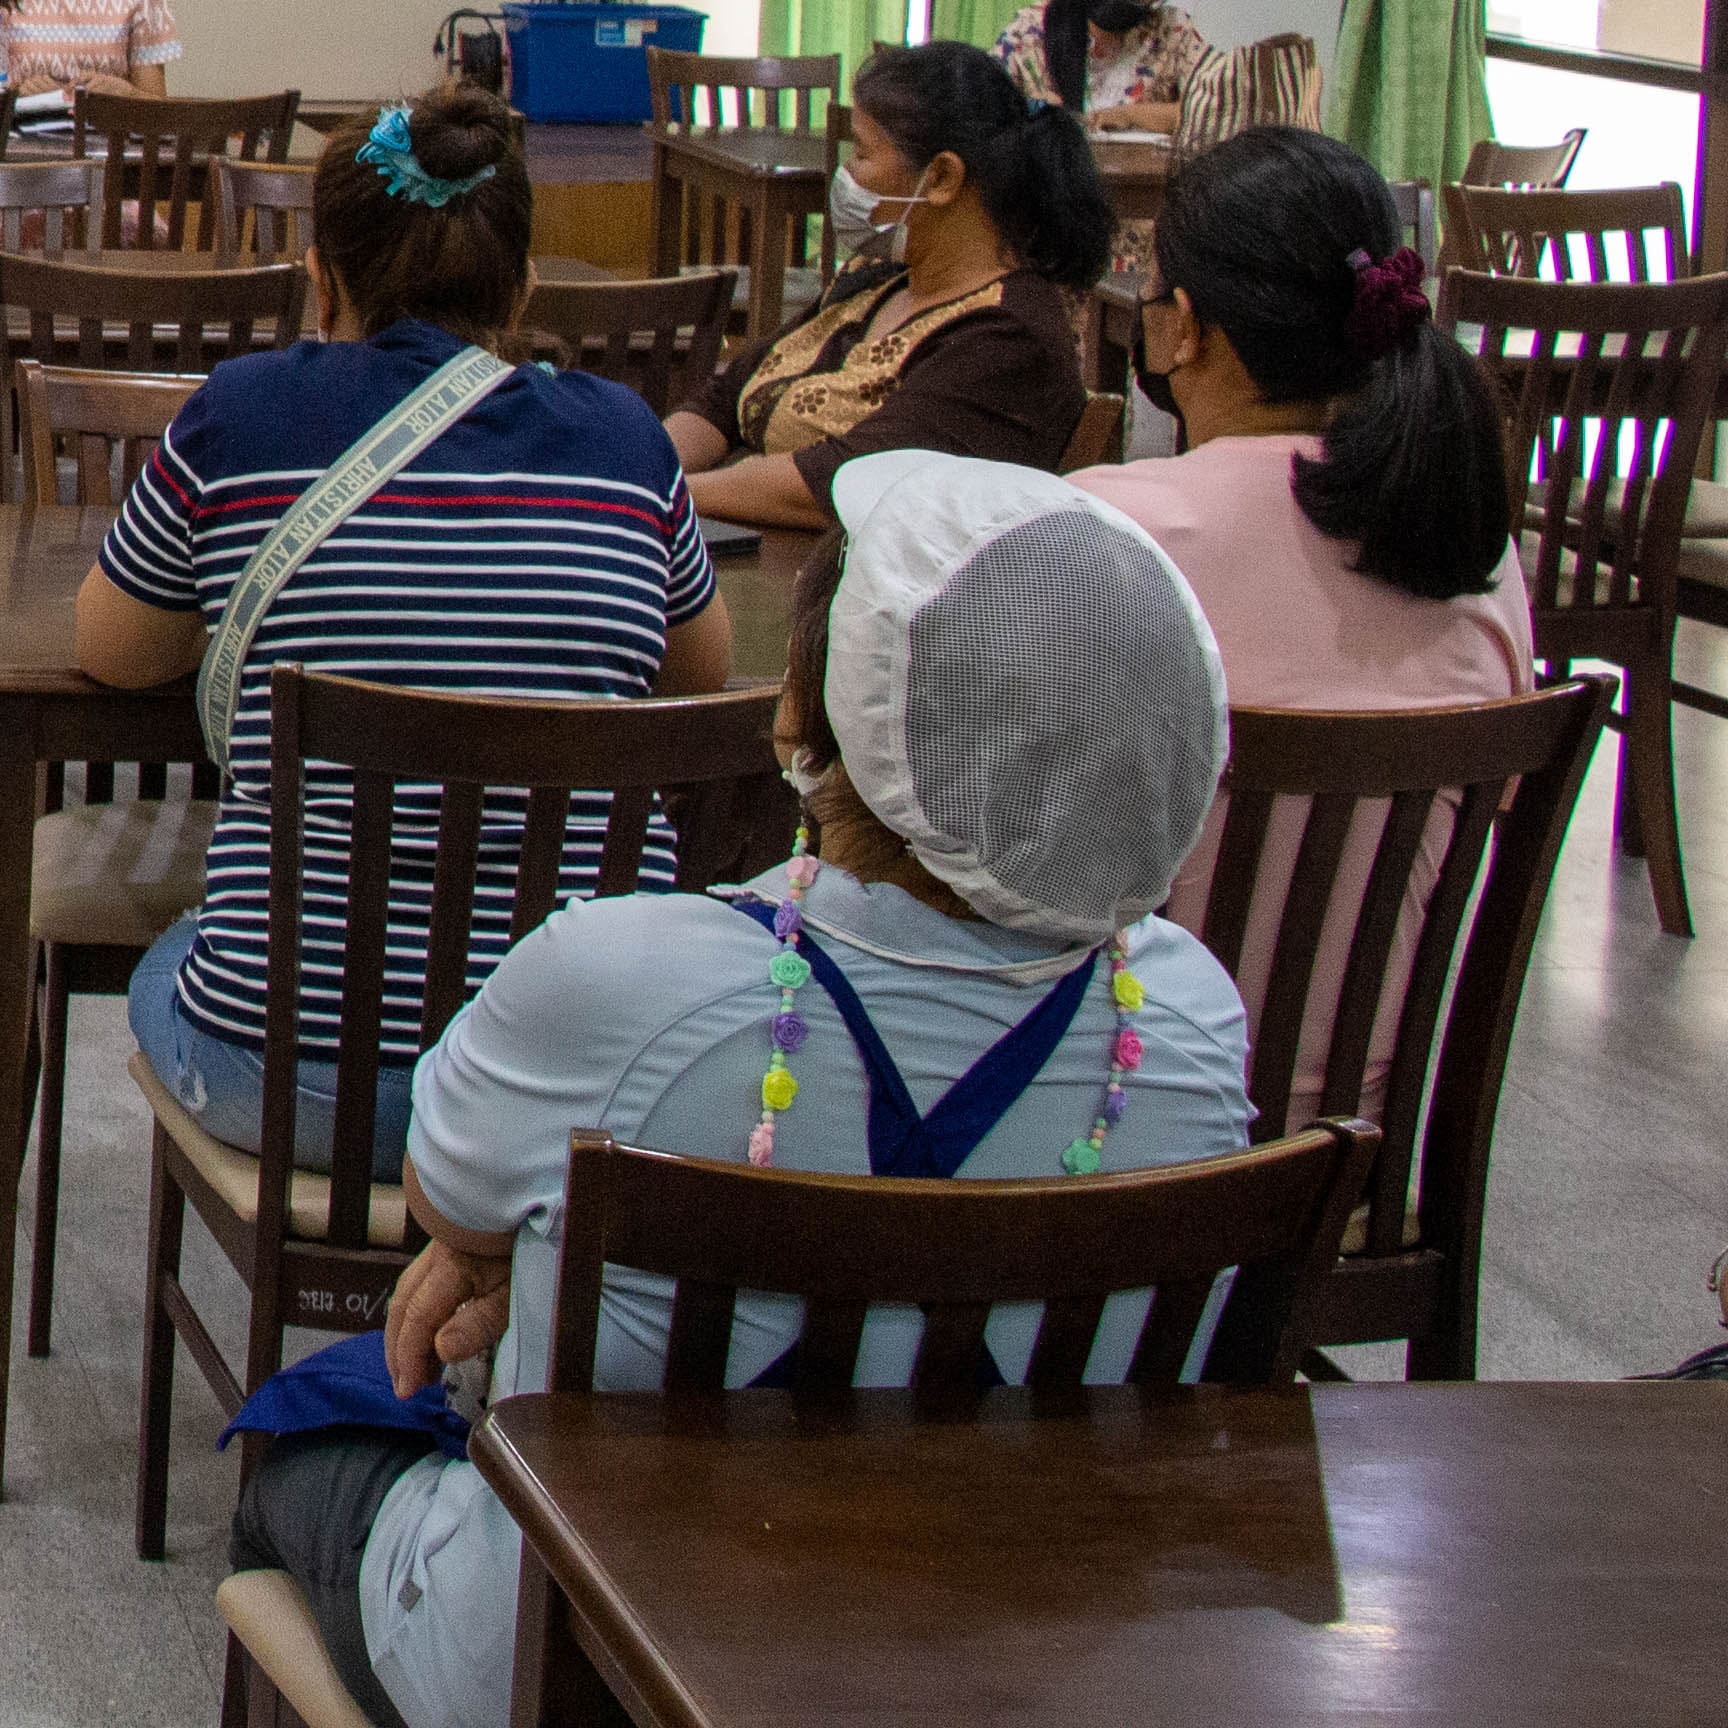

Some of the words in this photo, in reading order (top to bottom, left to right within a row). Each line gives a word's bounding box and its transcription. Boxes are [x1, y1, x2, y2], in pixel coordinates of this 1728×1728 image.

[404, 391, 449, 433] AIOR
[289, 456, 377, 544] AHRISITAN
[253, 543, 291, 591] AIOR
